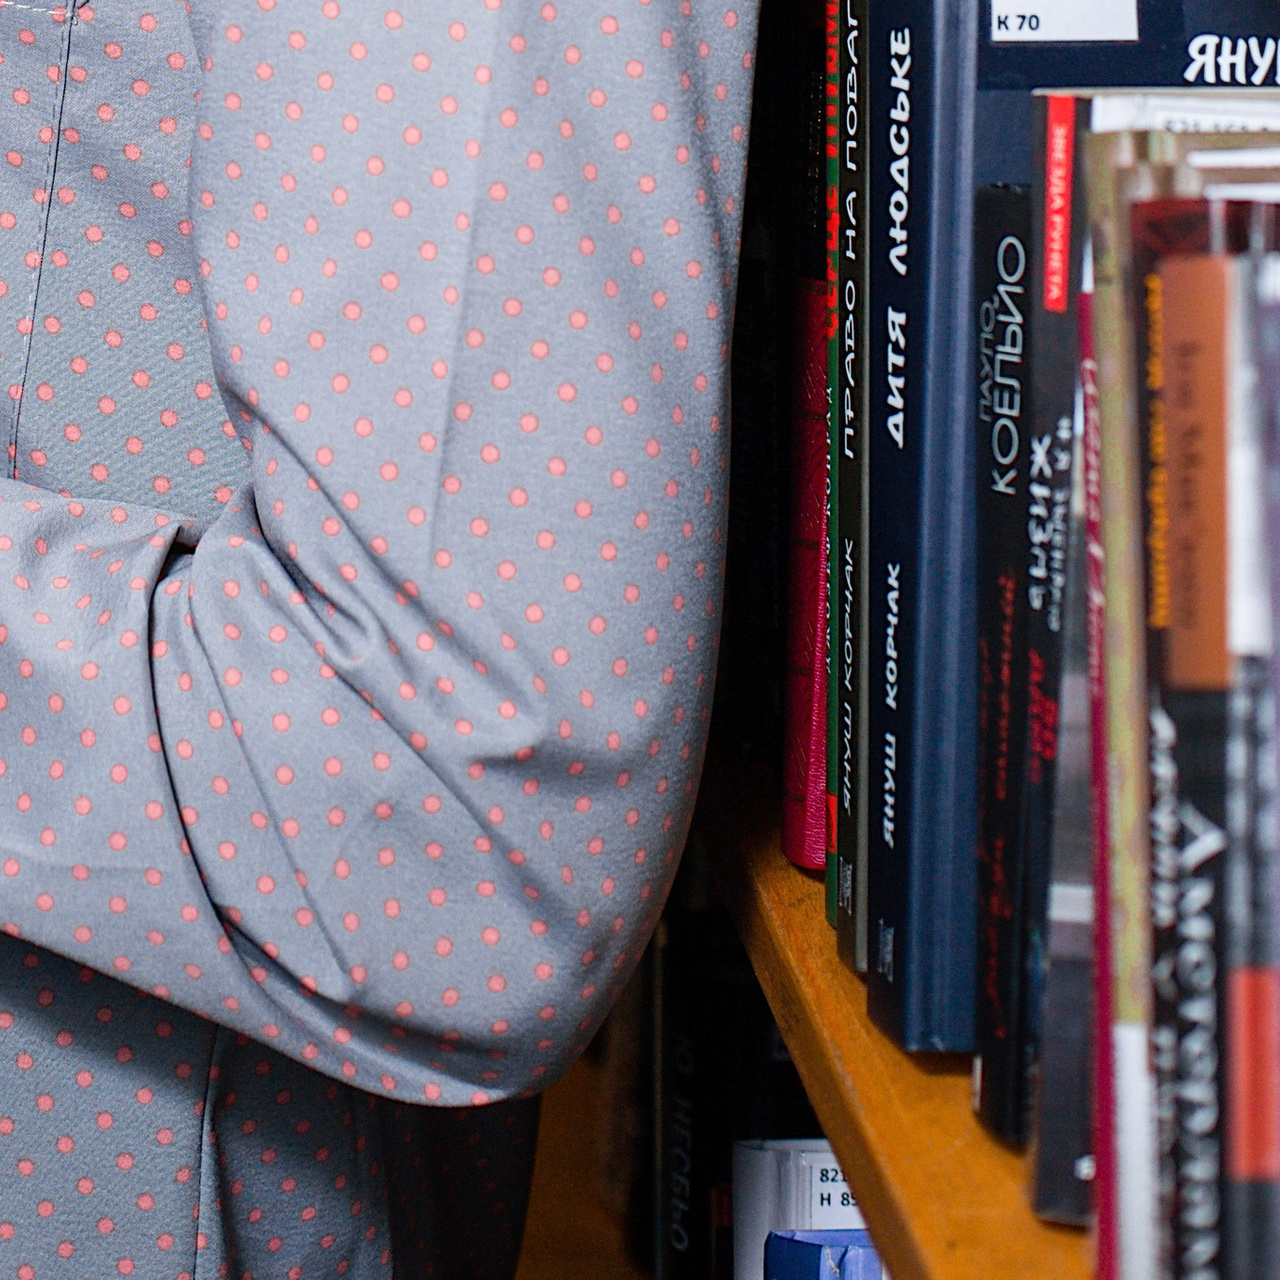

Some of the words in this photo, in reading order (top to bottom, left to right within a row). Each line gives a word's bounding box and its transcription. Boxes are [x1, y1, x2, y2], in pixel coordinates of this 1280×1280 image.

[997, 15, 1009, 31] К
[1016, 15, 1040, 31] 70
[1183, 34, 1280, 86] ЯНУ
[888, 27, 912, 276] ЛЮДСЬКЕ
[845, 191, 857, 260] НА
[844, 280, 856, 460] ПРАВО
[887, 306, 907, 450] ДИТЯ
[979, 299, 994, 422] ПАУЛО
[991, 235, 1026, 495] КОЕЛЬЙО
[844, 538, 854, 692] КОРЧАК
[885, 562, 901, 711] КОРЧАК
[843, 702, 853, 817] ЯНУШ
[883, 731, 897, 850] ЯНУШ
[820, 1192, 831, 1207] Н
